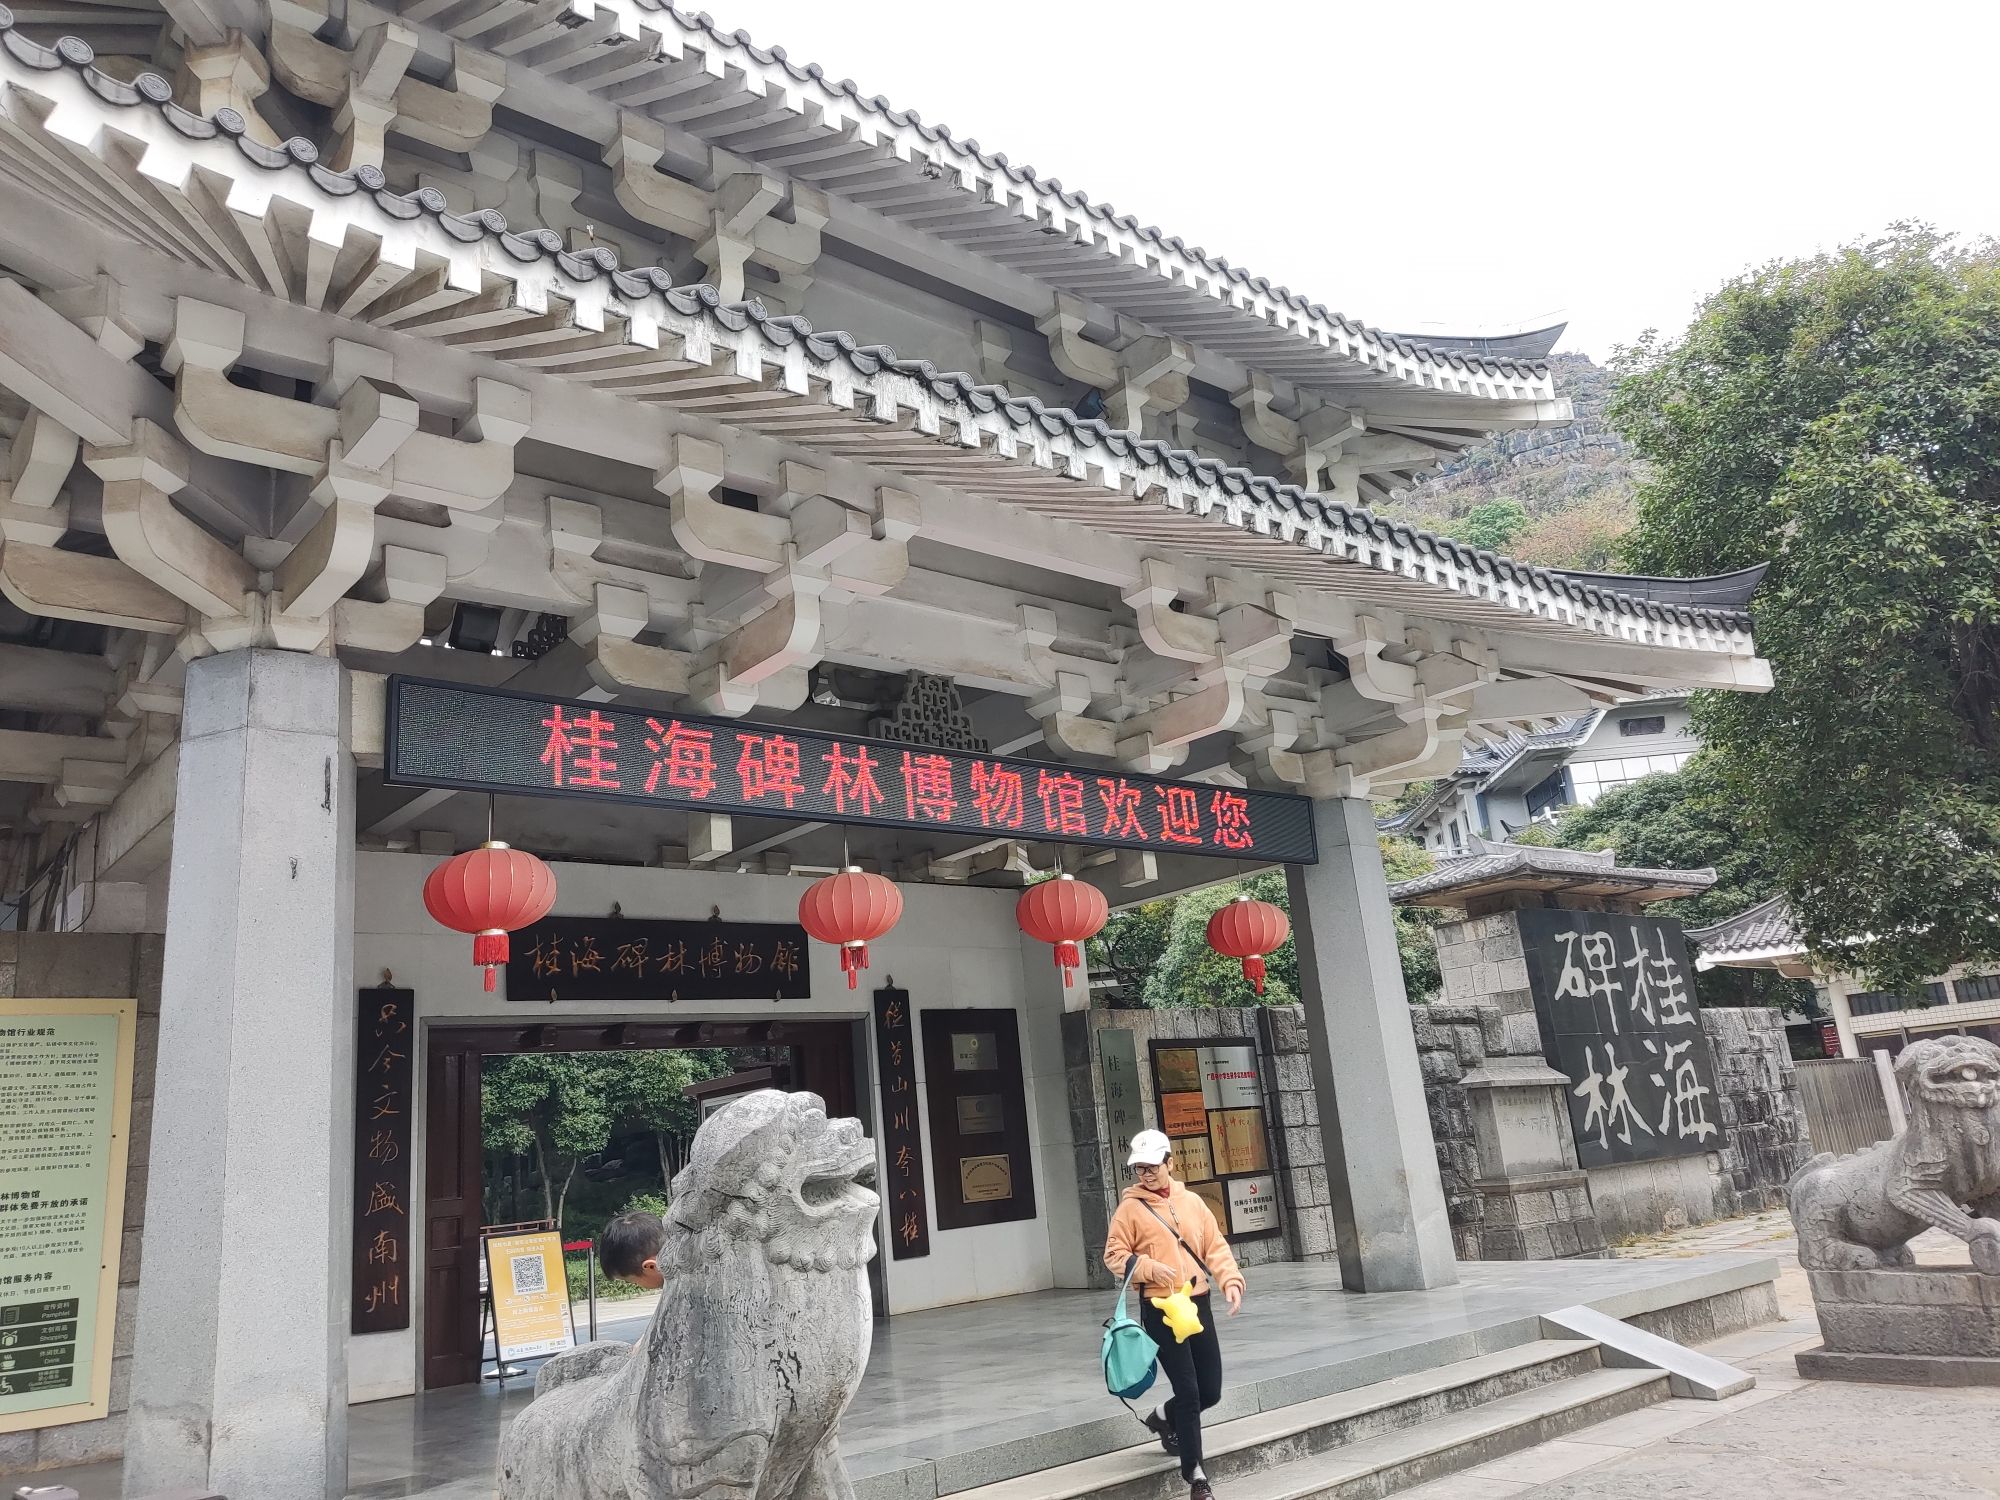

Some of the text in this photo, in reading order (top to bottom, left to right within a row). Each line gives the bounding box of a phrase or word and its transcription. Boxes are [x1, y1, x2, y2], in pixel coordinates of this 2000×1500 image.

[540, 704, 1255, 851] 桂海碑林博物馆欢迎您
[1108, 1055, 1133, 1182] 桂海碑林博
[1, 1190, 40, 1200] 林博物馆
[0, 1198, 88, 1212] 群体免费开放的承诺
[0, 1272, 53, 1285] 馆服务内容
[41, 1311, 70, 1319] Pamphlet
